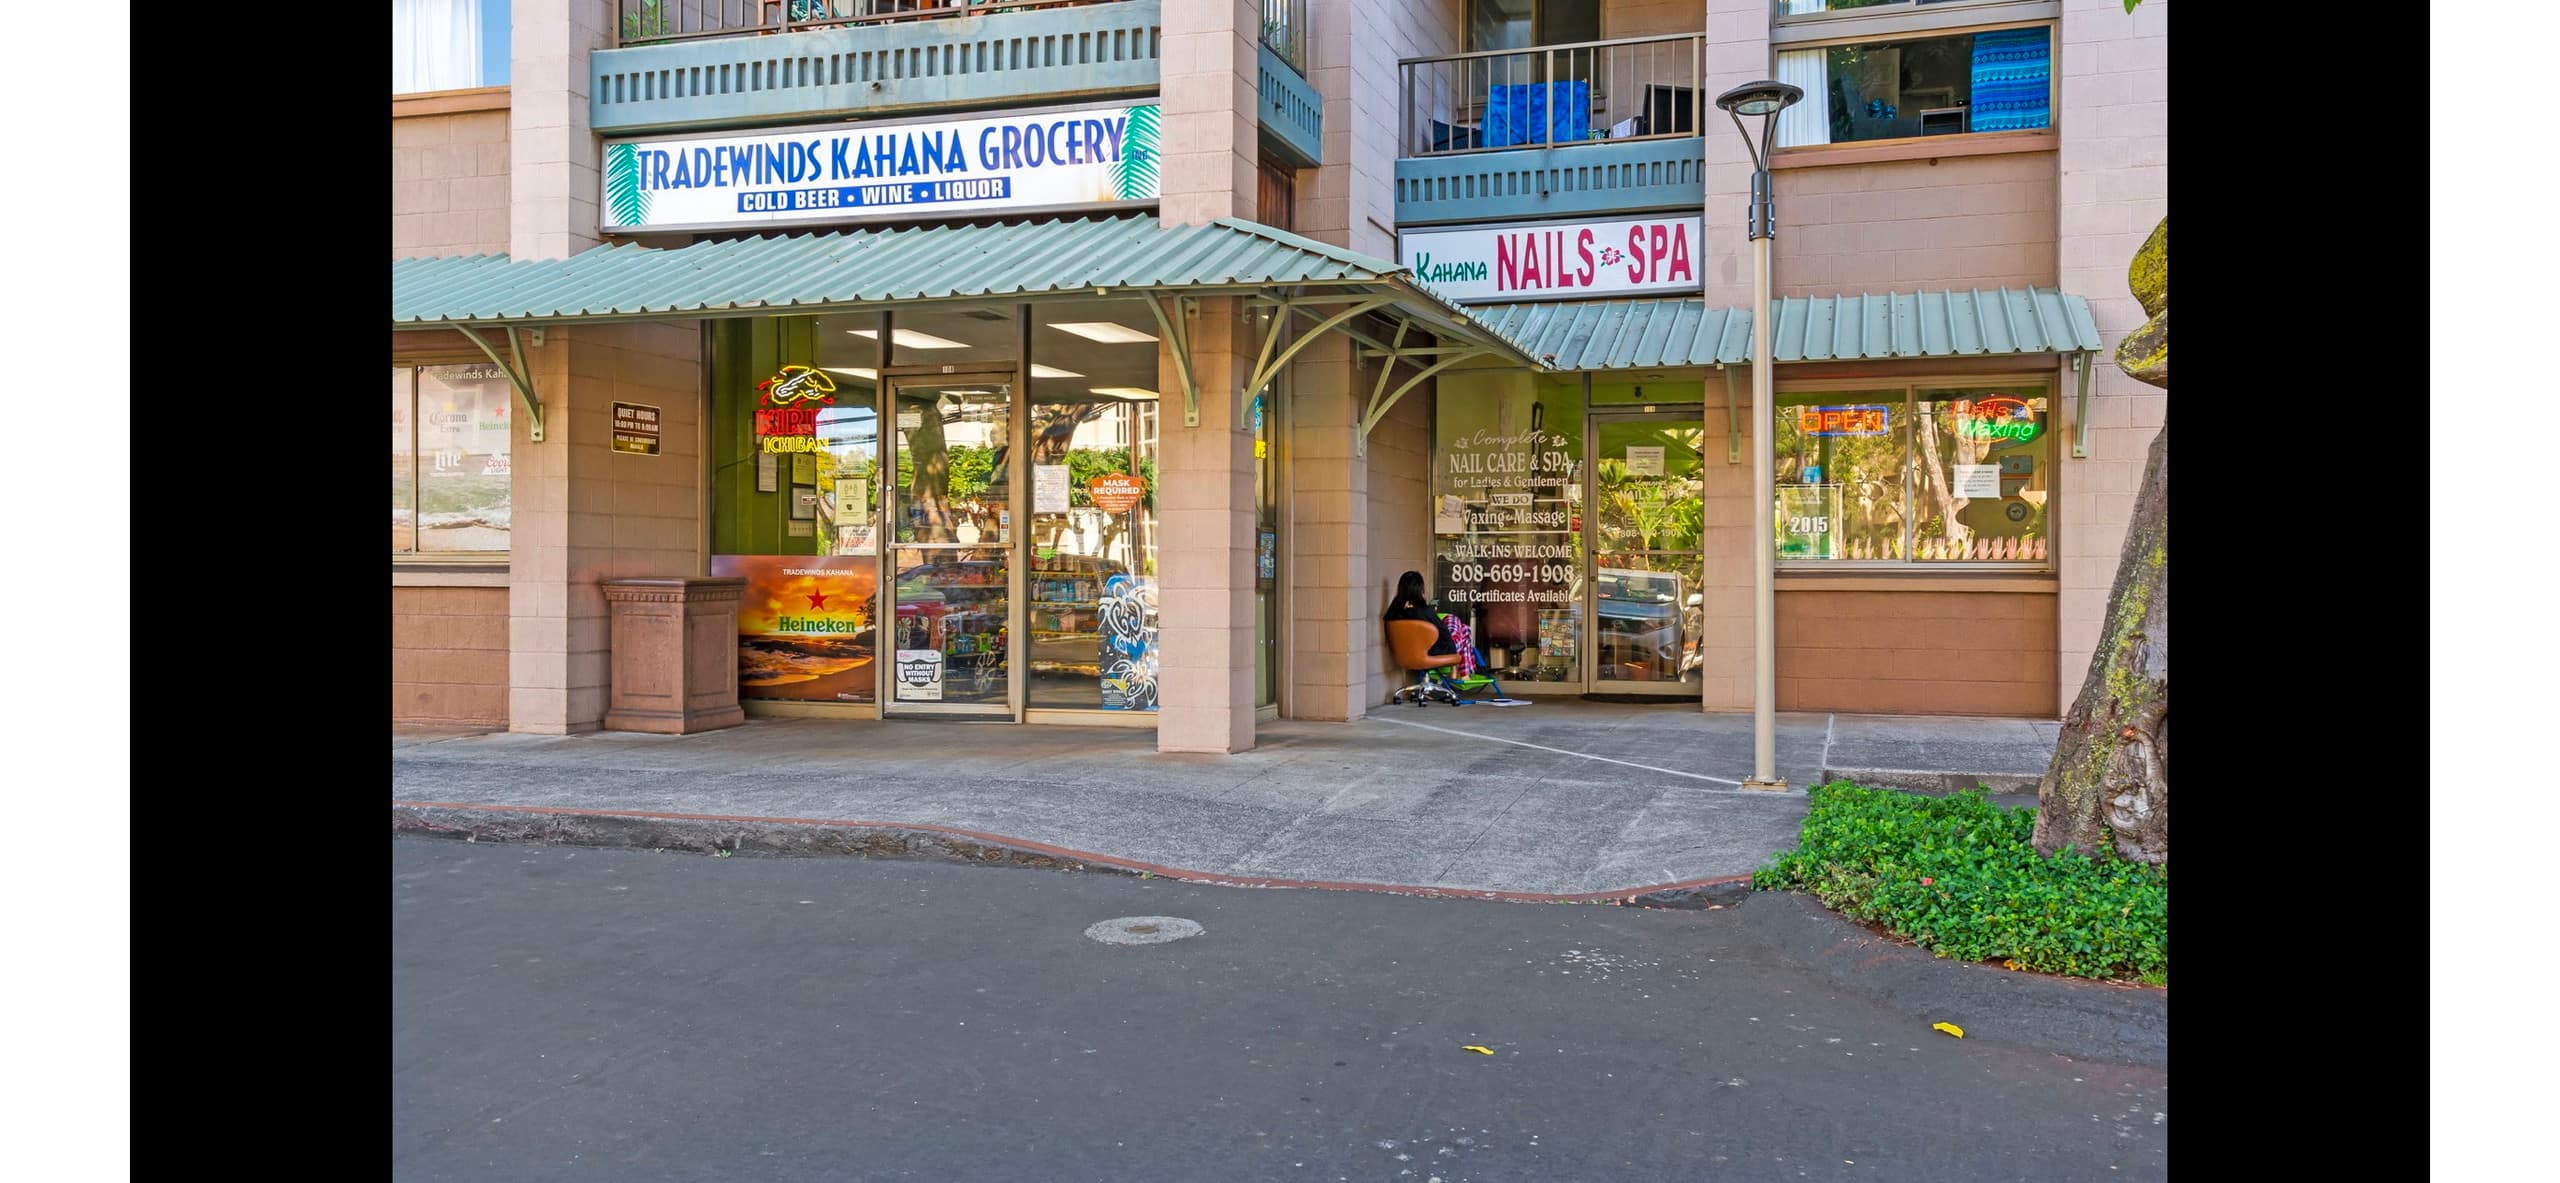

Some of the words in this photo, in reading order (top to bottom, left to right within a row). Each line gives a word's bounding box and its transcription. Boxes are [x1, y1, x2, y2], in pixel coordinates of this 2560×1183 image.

[637, 140, 823, 191] TRADEWINDS
[831, 128, 968, 180] KAHANA
[978, 117, 1127, 171] GROCERY
[743, 191, 790, 212] COLD
[795, 189, 840, 210] BEER
[862, 184, 914, 205] WINE
[934, 179, 1005, 202] LIQUOR
[1497, 228, 1595, 292] NAILS
[1627, 223, 1692, 285] SPA
[430, 370, 483, 380] adewinds
[756, 408, 823, 436] KIRI
[1801, 411, 1883, 432] OPEN
[1958, 420, 2037, 441] Waxing
[763, 437, 830, 454] ICHIBAN
[1473, 428, 1548, 451] Complete
[1450, 453, 1484, 473] NAIL
[1487, 452, 1526, 473] CARE
[1529, 454, 1540, 471] &
[1542, 451, 1570, 472] SPA
[1093, 487, 1140, 495] REQUIRED
[1103, 479, 1130, 487] MASK
[1454, 476, 1468, 488] for
[1470, 476, 1502, 488] Ladies
[1503, 477, 1512, 487] &
[1514, 476, 1569, 489] Gentlemen
[1491, 495, 1510, 505] WE
[1512, 495, 1529, 504] DO
[1514, 509, 1566, 528] Massage
[1790, 516, 1829, 533] 2015
[1455, 544, 1511, 559] WALK-INS
[1513, 544, 1573, 559] WELCOME
[783, 568, 825, 576] TRADEWINDS
[825, 568, 854, 576] KAHANA
[1451, 564, 1574, 583] 808-669-1908
[1448, 589, 1468, 602] Gift
[1469, 589, 1525, 602] Certificates
[778, 616, 856, 633] Heineken
